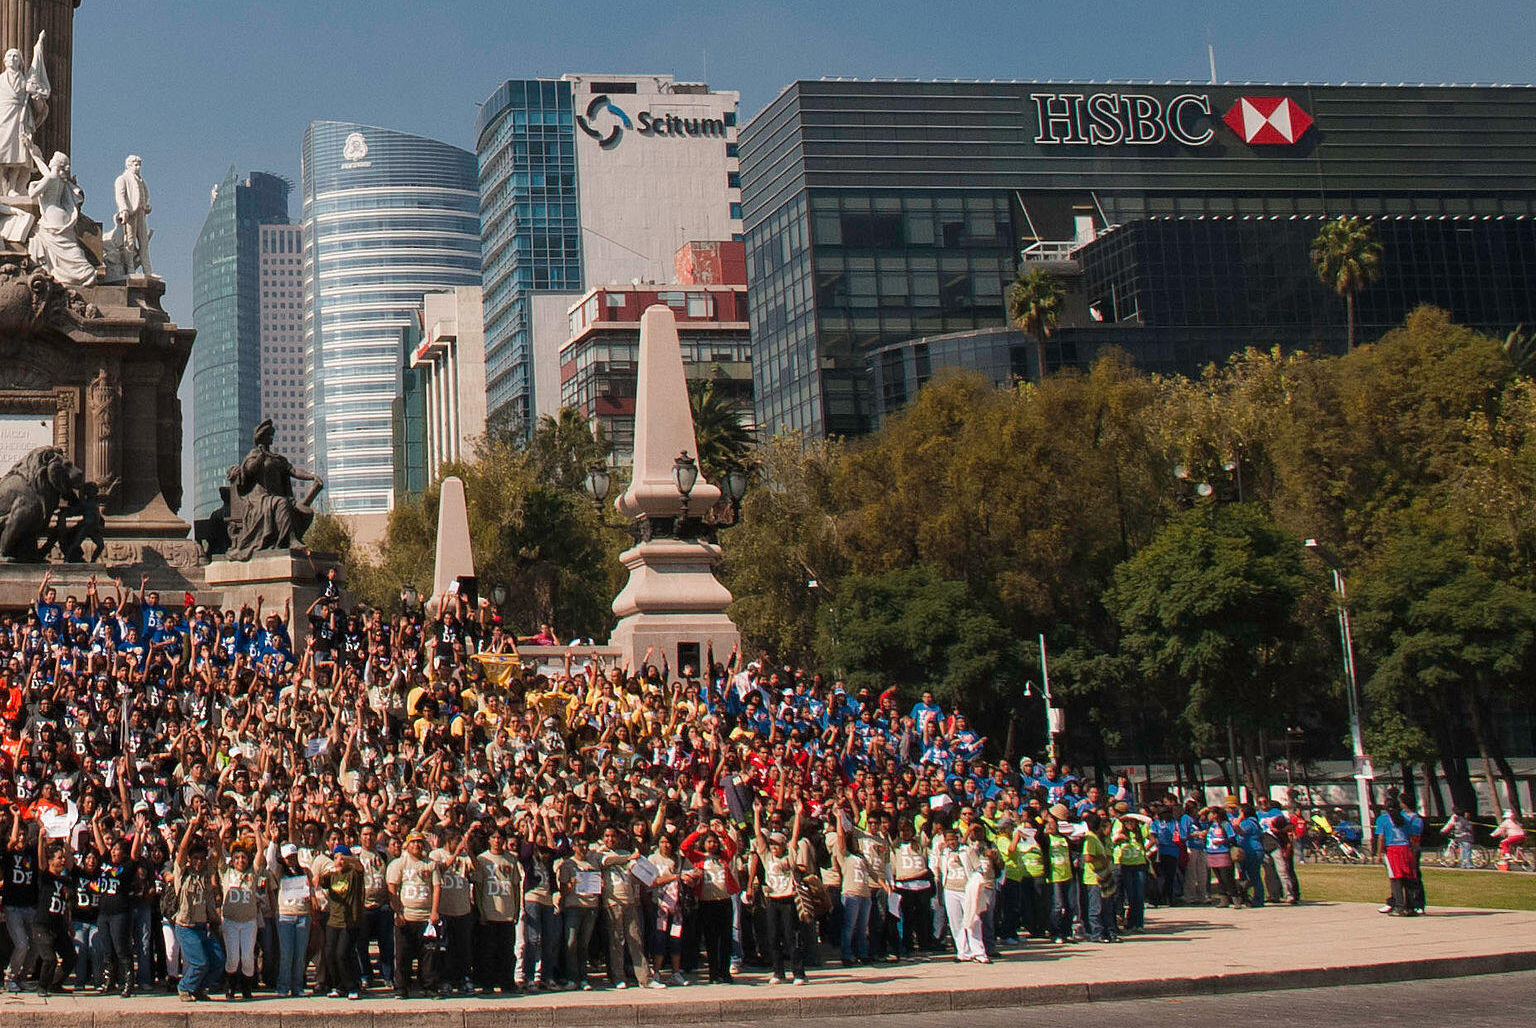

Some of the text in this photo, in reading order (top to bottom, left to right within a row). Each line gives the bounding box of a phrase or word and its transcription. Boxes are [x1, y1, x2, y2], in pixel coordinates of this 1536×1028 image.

[637, 111, 724, 136] Scitum
[1030, 93, 1214, 146] HSBC
[150, 696, 160, 706] D
[74, 732, 84, 742] Y
[14, 856, 22, 868] Y
[902, 856, 924, 869] DF
[12, 868, 32, 884] DF
[443, 875, 464, 889] DF
[54, 880, 63, 896] Y
[229, 888, 251, 903] DF
[404, 884, 430, 900] DF
[488, 880, 512, 896] DF
[78, 892, 101, 906] DF
